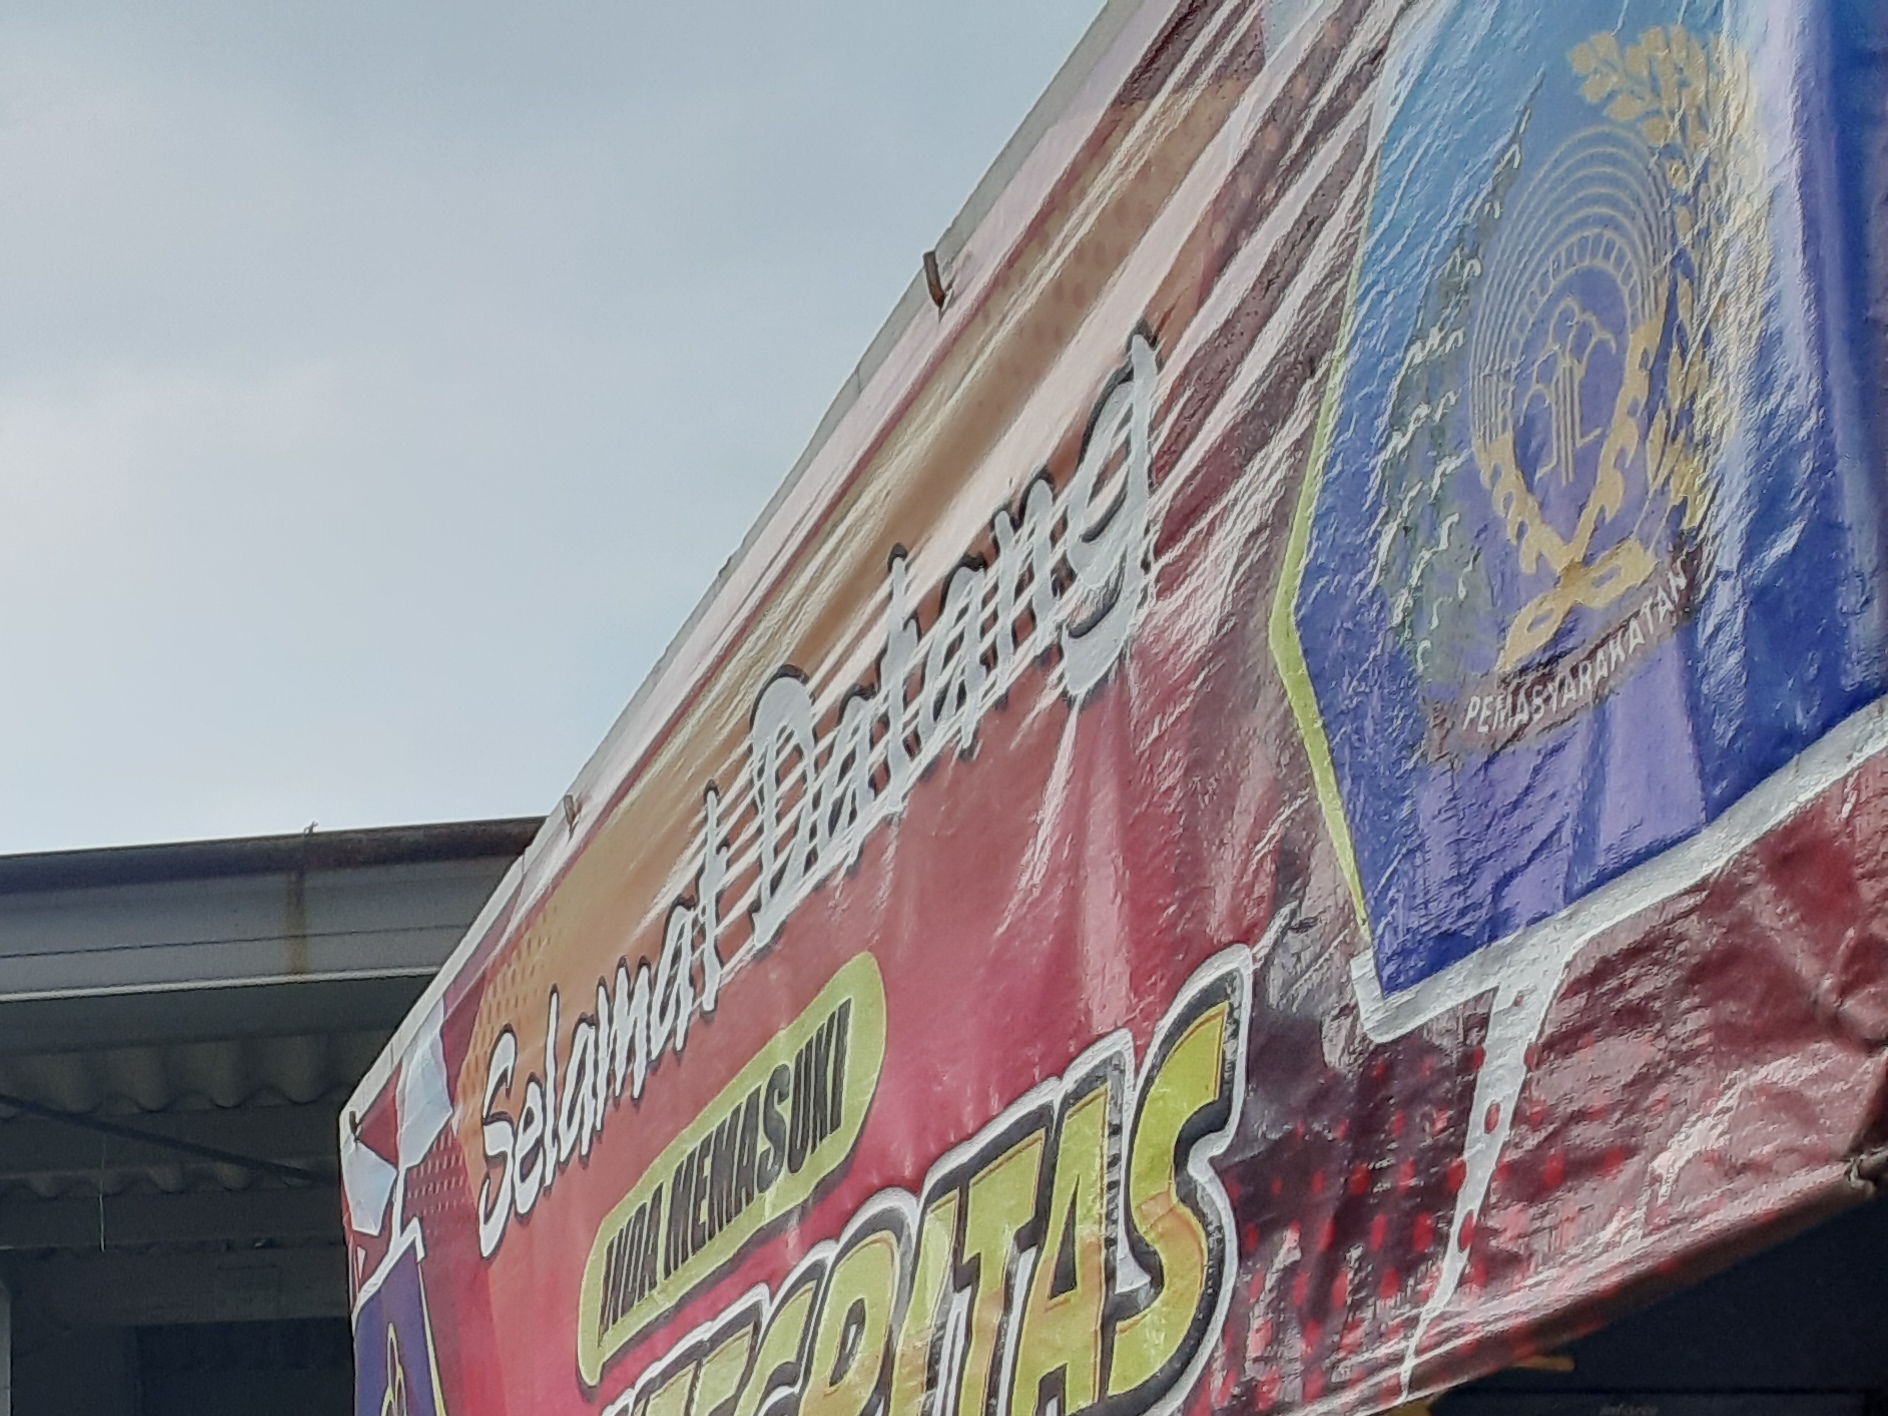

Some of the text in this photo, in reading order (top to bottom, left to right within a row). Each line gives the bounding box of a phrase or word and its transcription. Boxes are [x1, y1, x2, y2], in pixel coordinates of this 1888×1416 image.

[1462, 555, 1687, 733] PEMASYARAKATAN
[478, 331, 1158, 1259] Selamat Datang
[664, 997, 852, 1281] MEMASUKI
